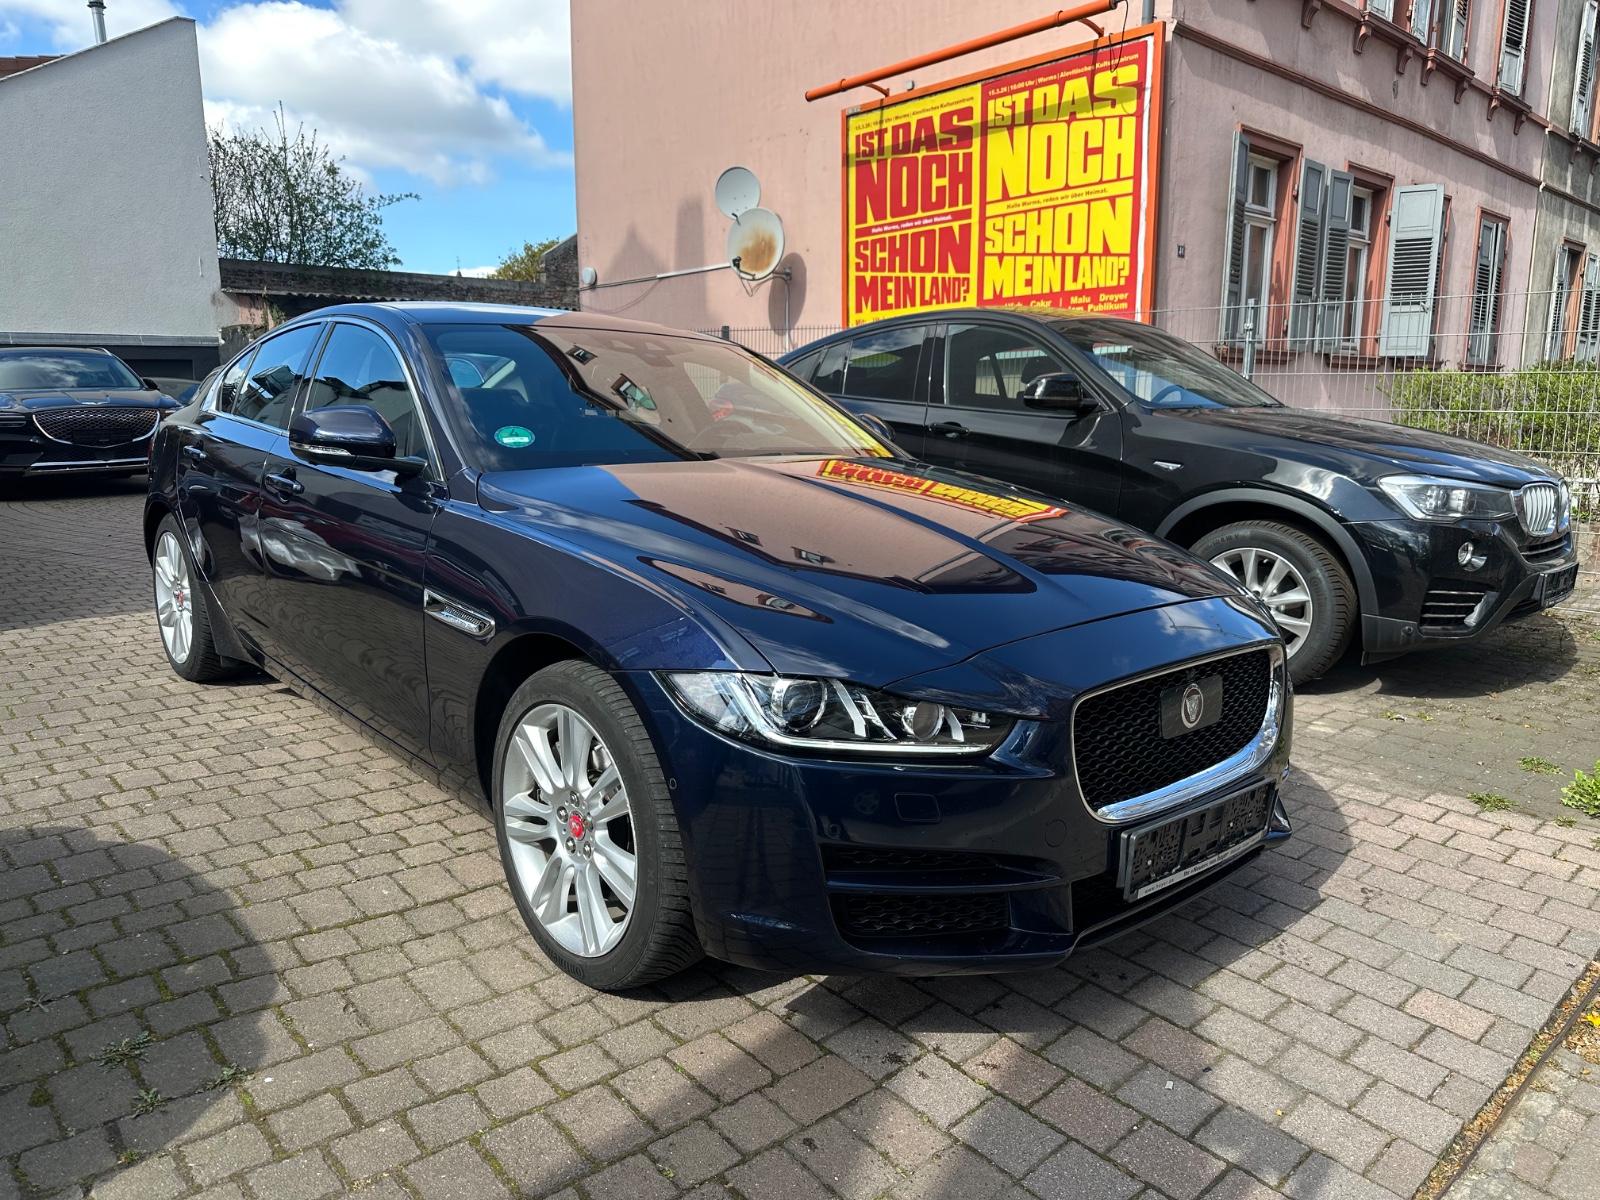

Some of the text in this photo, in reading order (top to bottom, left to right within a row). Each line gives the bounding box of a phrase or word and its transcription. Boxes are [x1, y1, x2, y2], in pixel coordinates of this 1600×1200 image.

[987, 64, 1138, 127] IST DAS
[1038, 74, 1057, 84] Worms
[855, 106, 974, 158] IST DAS
[987, 115, 1136, 202] NOCH
[855, 153, 973, 225] NOCH
[855, 222, 971, 274] SCHON
[985, 195, 1133, 254] SCHON
[855, 275, 970, 314] MEIN LAND?
[983, 255, 1129, 301] MEIN LAND?
[1070, 295, 1091, 305] Malu
[1099, 292, 1129, 303] Dreyer
[1087, 302, 1129, 313] Publikum
